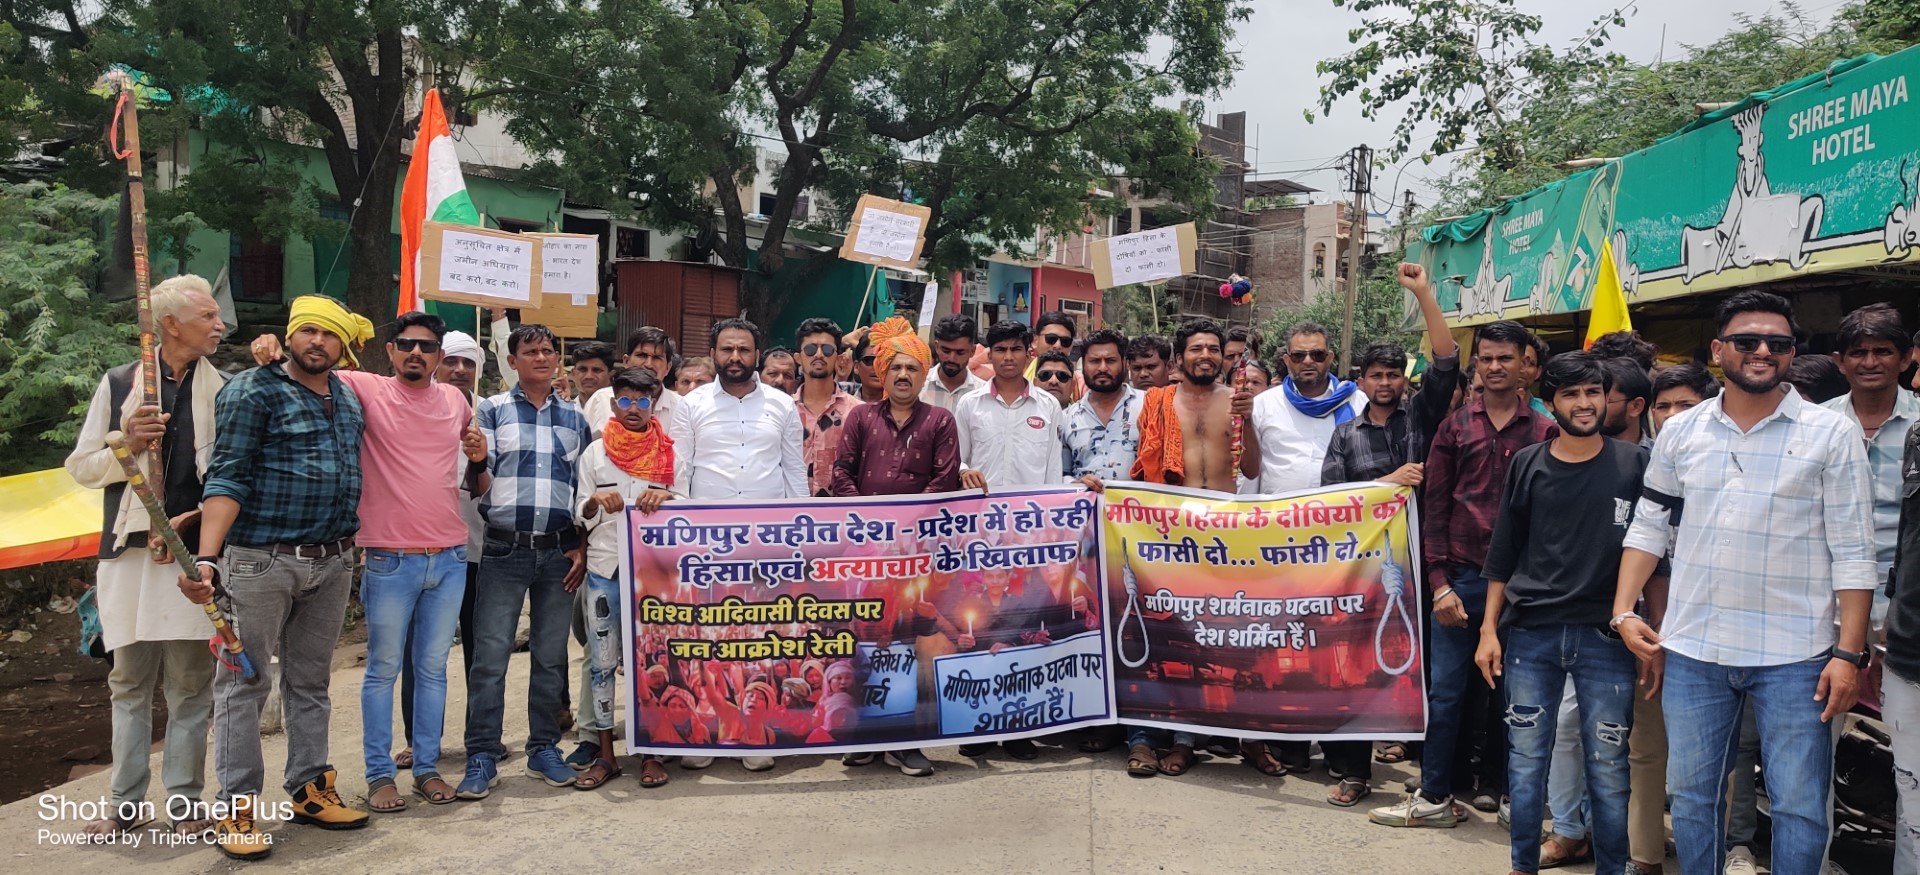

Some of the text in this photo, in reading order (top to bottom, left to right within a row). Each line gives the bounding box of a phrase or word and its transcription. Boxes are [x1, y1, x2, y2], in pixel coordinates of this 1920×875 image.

[1788, 75, 1908, 140] SHREE MAYA
[1812, 123, 1876, 166] HOTEL
[1502, 208, 1544, 237] SHREE MAYA
[454, 238, 492, 251] अनुसूचित
[496, 243, 510, 252] क्षेत्र
[454, 255, 478, 266] जमीन
[1509, 234, 1530, 256] HOTEL
[640, 516, 750, 553] मणिपुर
[756, 514, 840, 548] सहीत
[846, 513, 896, 542] देश
[918, 508, 978, 540] प्रदेश
[984, 503, 1008, 530] में
[1012, 502, 1044, 532] हो
[1050, 498, 1093, 529] रही
[1106, 497, 1180, 534] मणिपुर
[1246, 506, 1271, 528] के
[1276, 496, 1364, 528] दोषियों
[680, 542, 1077, 586] हिंसा एवं अत्याचार के खिलाफ
[1138, 534, 1200, 564] फांसी
[1260, 536, 1330, 565] फांसी
[642, 596, 882, 624] विश्व आदिवासी दिवस पर
[1144, 588, 1364, 621] मणिपुर शर्मनाक घटना पर
[670, 632, 854, 659] जन आक्रोश रेली
[1194, 622, 1225, 646] देश
[1228, 622, 1286, 647] शर्मिंदा
[944, 654, 1102, 710] मणिपुर शर्मनाक घटना पर
